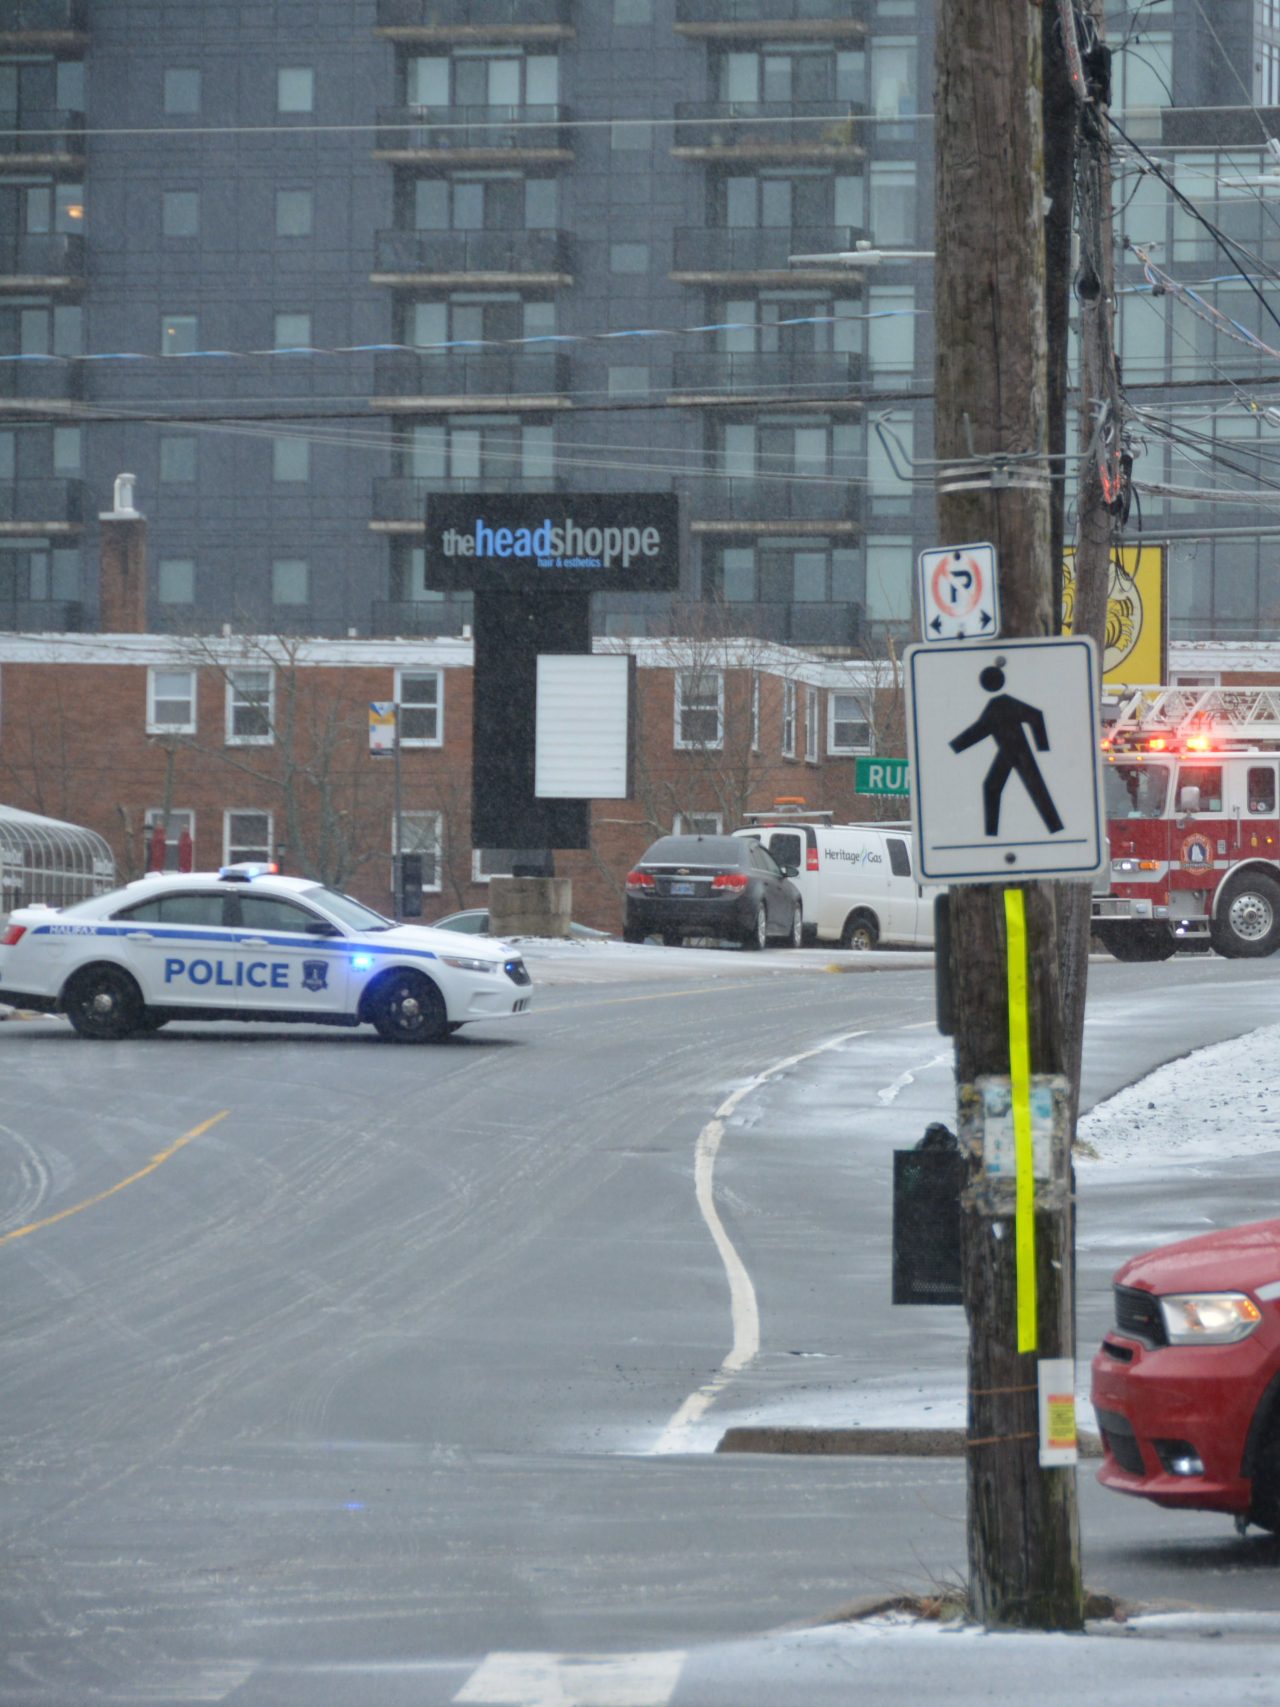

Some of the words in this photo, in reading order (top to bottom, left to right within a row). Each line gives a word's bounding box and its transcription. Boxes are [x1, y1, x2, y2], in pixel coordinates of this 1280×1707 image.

[537, 557, 553, 568] hair
[555, 557, 562, 568] &
[564, 557, 601, 568] esthetics
[824, 848, 860, 864] Heritage
[867, 852, 882, 863] Gas
[49, 925, 97, 936] HALIFAX
[165, 958, 289, 988] POLICE
